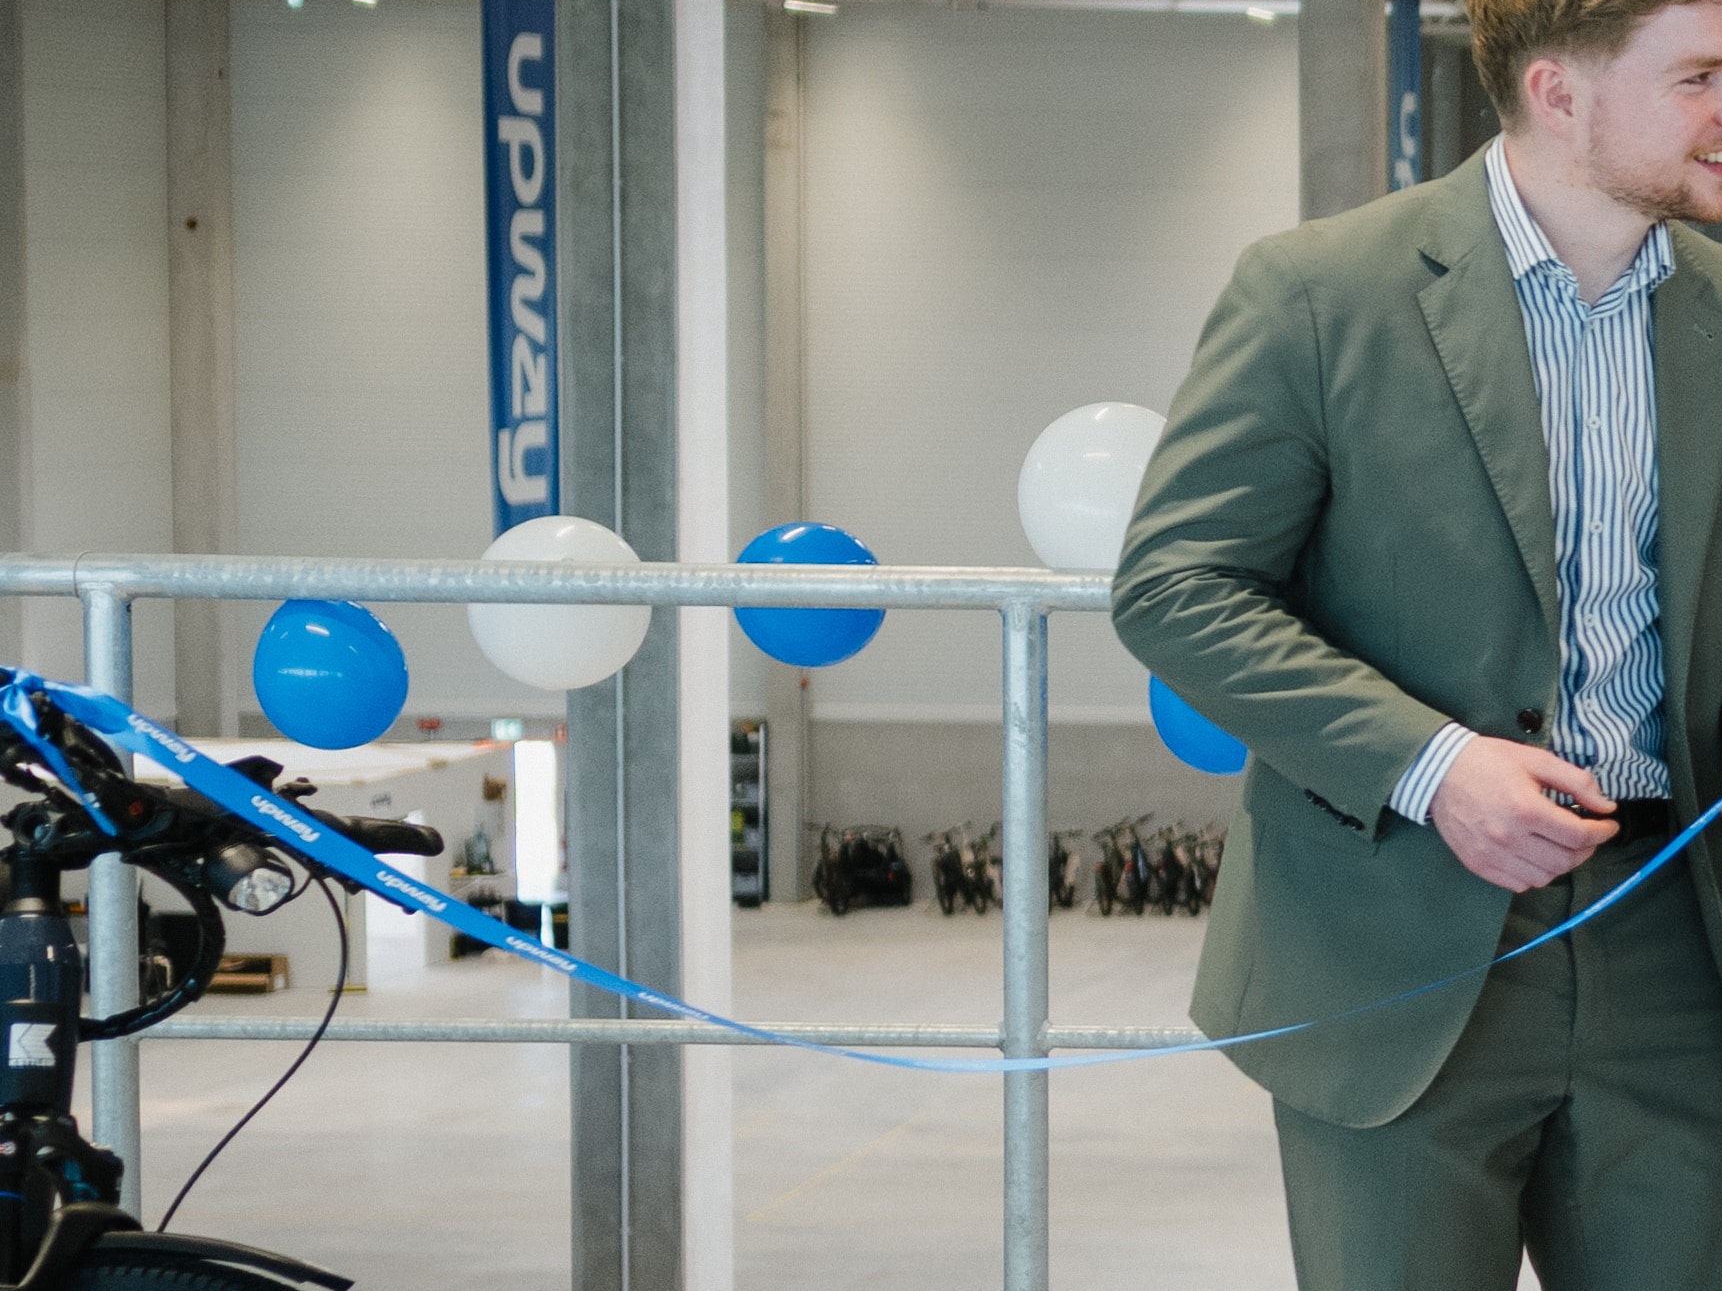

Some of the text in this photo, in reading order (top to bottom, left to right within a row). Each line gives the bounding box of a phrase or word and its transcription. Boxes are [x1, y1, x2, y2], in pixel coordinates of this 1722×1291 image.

[498, 31, 548, 507] upway
[128, 713, 197, 763] upway
[251, 794, 321, 843] upway
[375, 869, 447, 912] upway
[506, 935, 578, 972] upway
